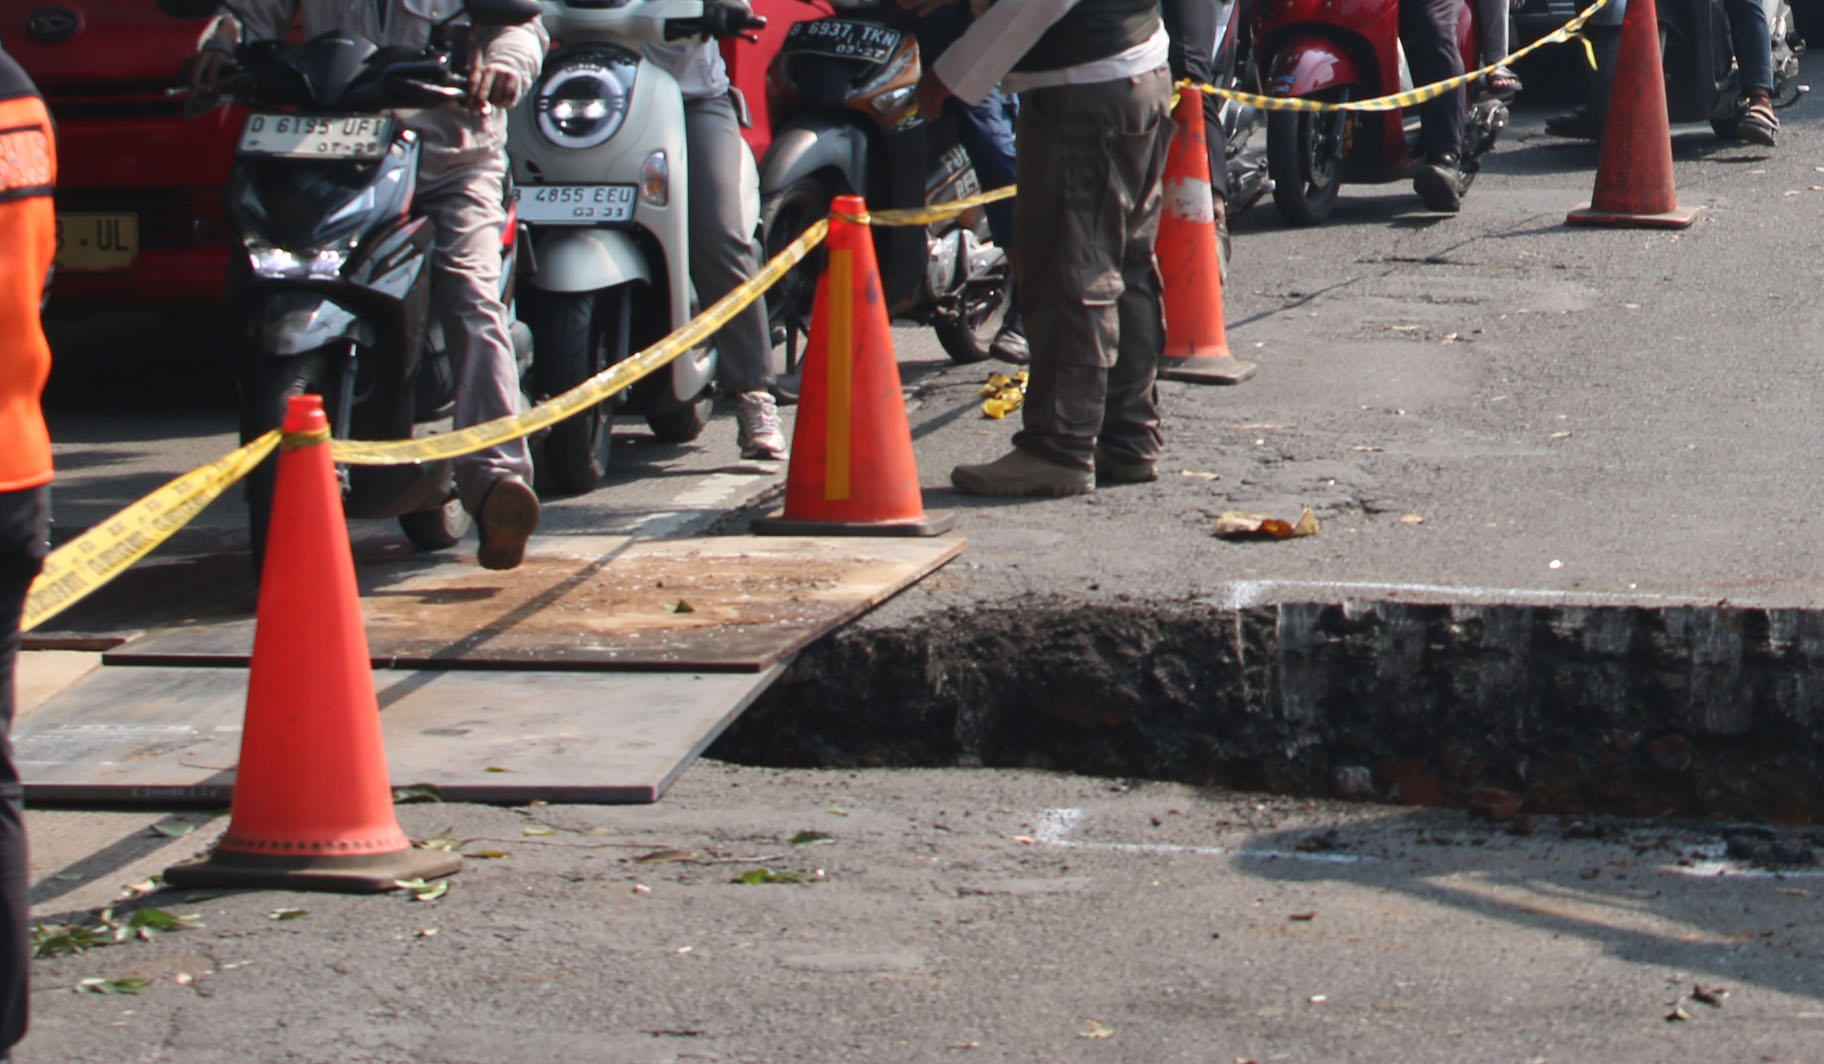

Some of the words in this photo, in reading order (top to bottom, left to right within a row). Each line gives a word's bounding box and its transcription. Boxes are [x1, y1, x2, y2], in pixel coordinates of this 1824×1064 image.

[808, 22, 852, 37] 6937
[862, 26, 895, 46] TKN
[277, 118, 330, 135] 6195
[536, 188, 585, 202] 4855
[594, 188, 631, 202] EEU
